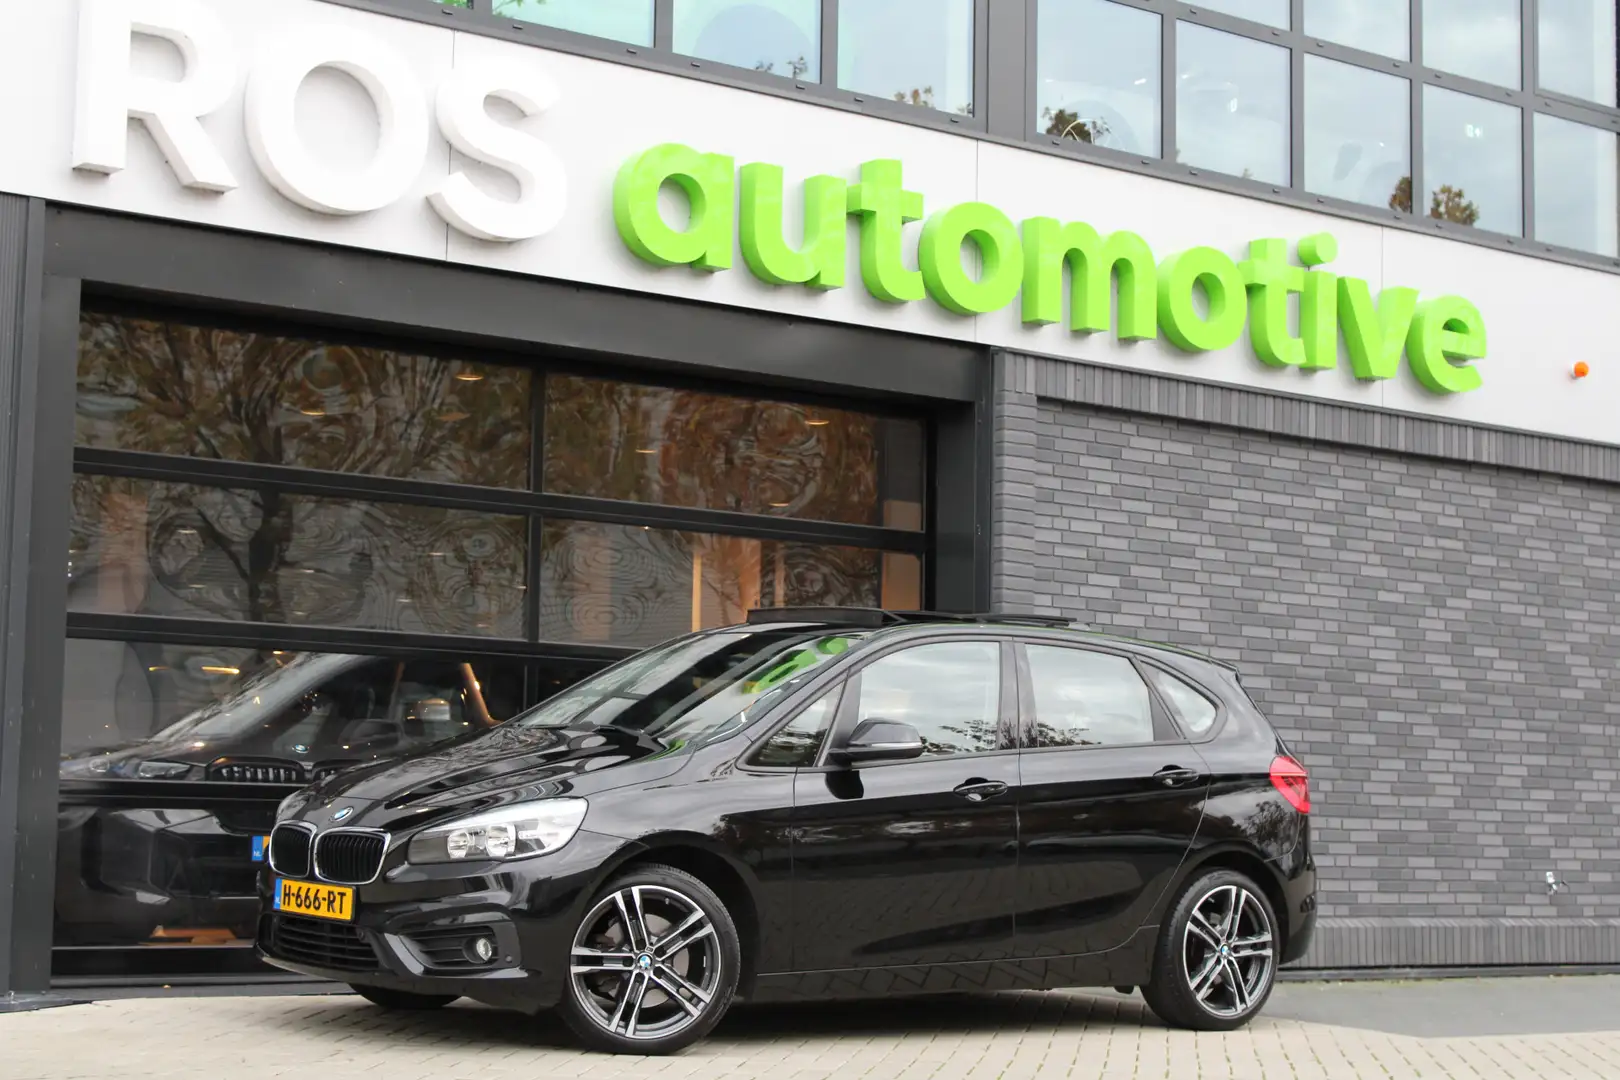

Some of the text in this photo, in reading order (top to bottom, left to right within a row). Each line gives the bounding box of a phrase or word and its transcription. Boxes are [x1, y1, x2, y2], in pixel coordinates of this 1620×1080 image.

[73, 0, 1487, 394] ROS automotive
[283, 884, 346, 914] H-666-RT
